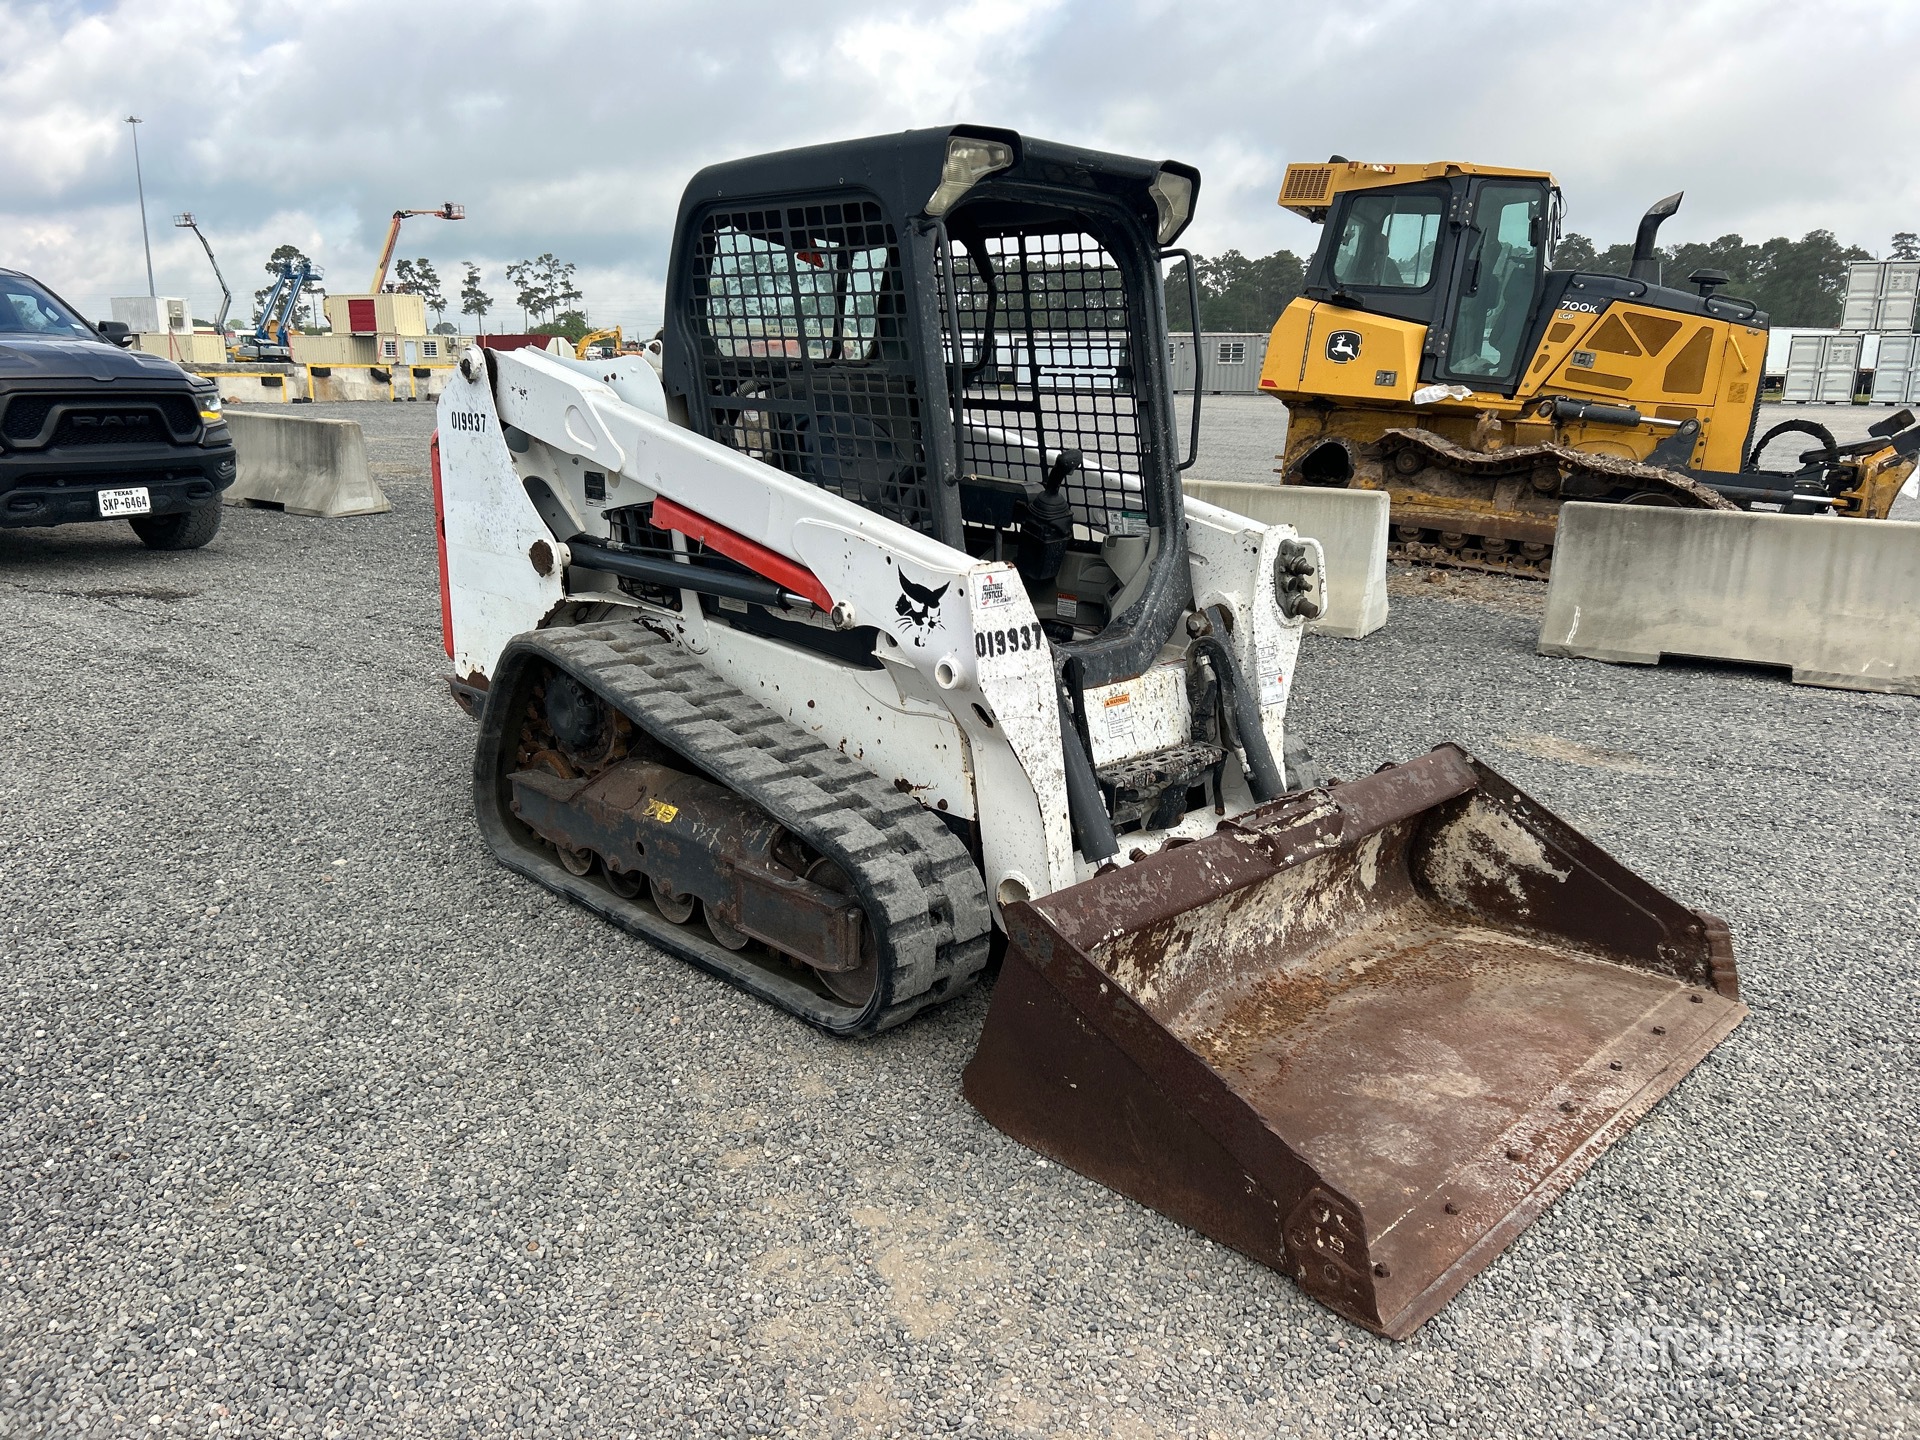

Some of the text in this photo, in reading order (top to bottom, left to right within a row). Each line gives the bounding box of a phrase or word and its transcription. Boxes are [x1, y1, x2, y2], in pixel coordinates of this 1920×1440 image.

[1561, 300, 1598, 313] 700K
[72, 415, 149, 428] RAM
[451, 411, 486, 433] 019937
[975, 621, 1042, 658] 019937
